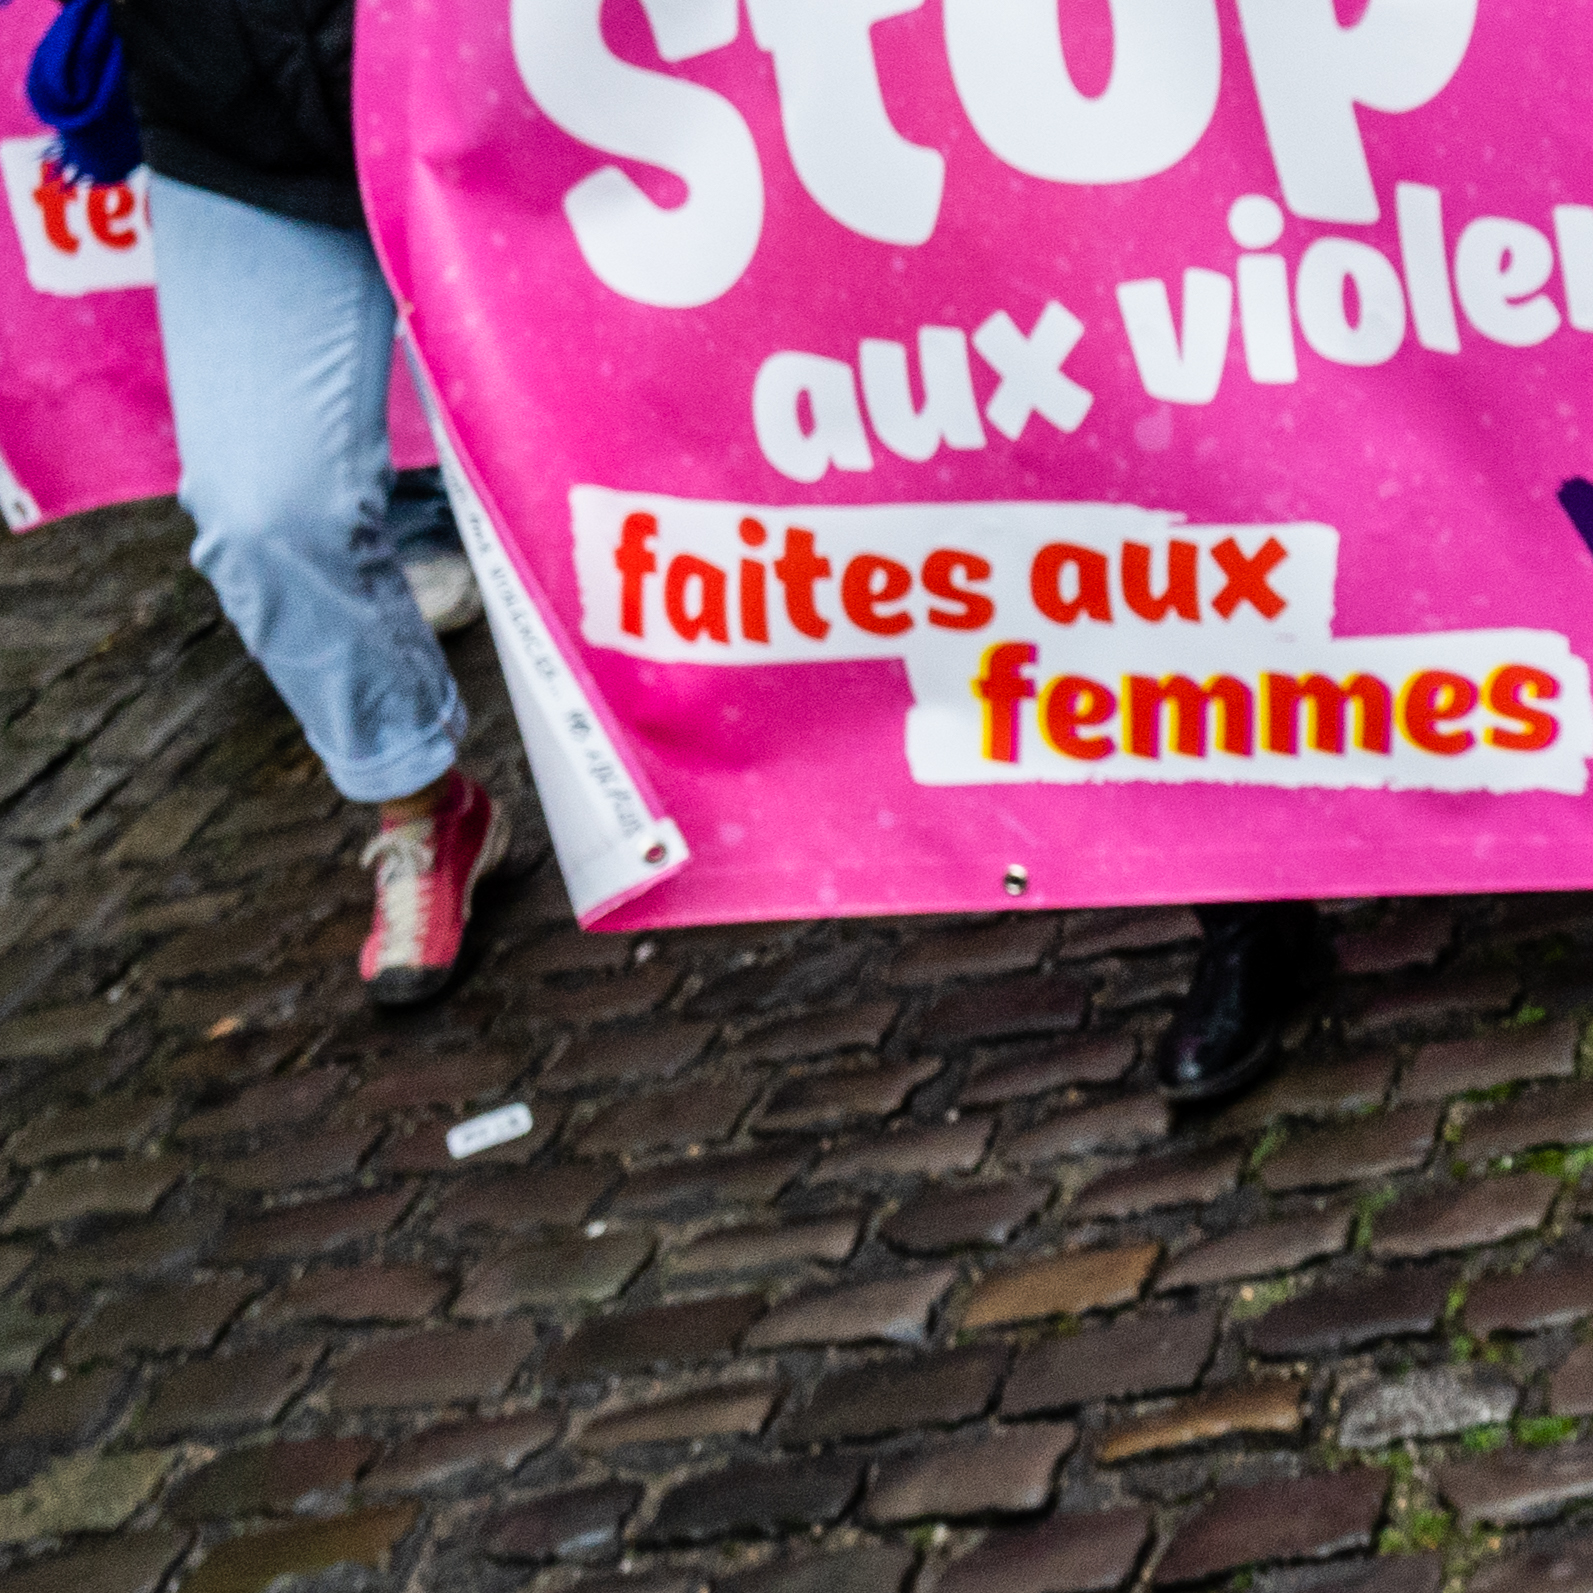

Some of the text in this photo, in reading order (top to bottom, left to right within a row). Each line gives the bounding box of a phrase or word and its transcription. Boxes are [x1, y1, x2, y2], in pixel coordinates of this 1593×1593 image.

[32, 158, 153, 255] te
[752, 300, 1095, 483] aux
[614, 512, 997, 646] faites
[1030, 534, 1289, 627] aux
[970, 642, 1563, 766] femmes
